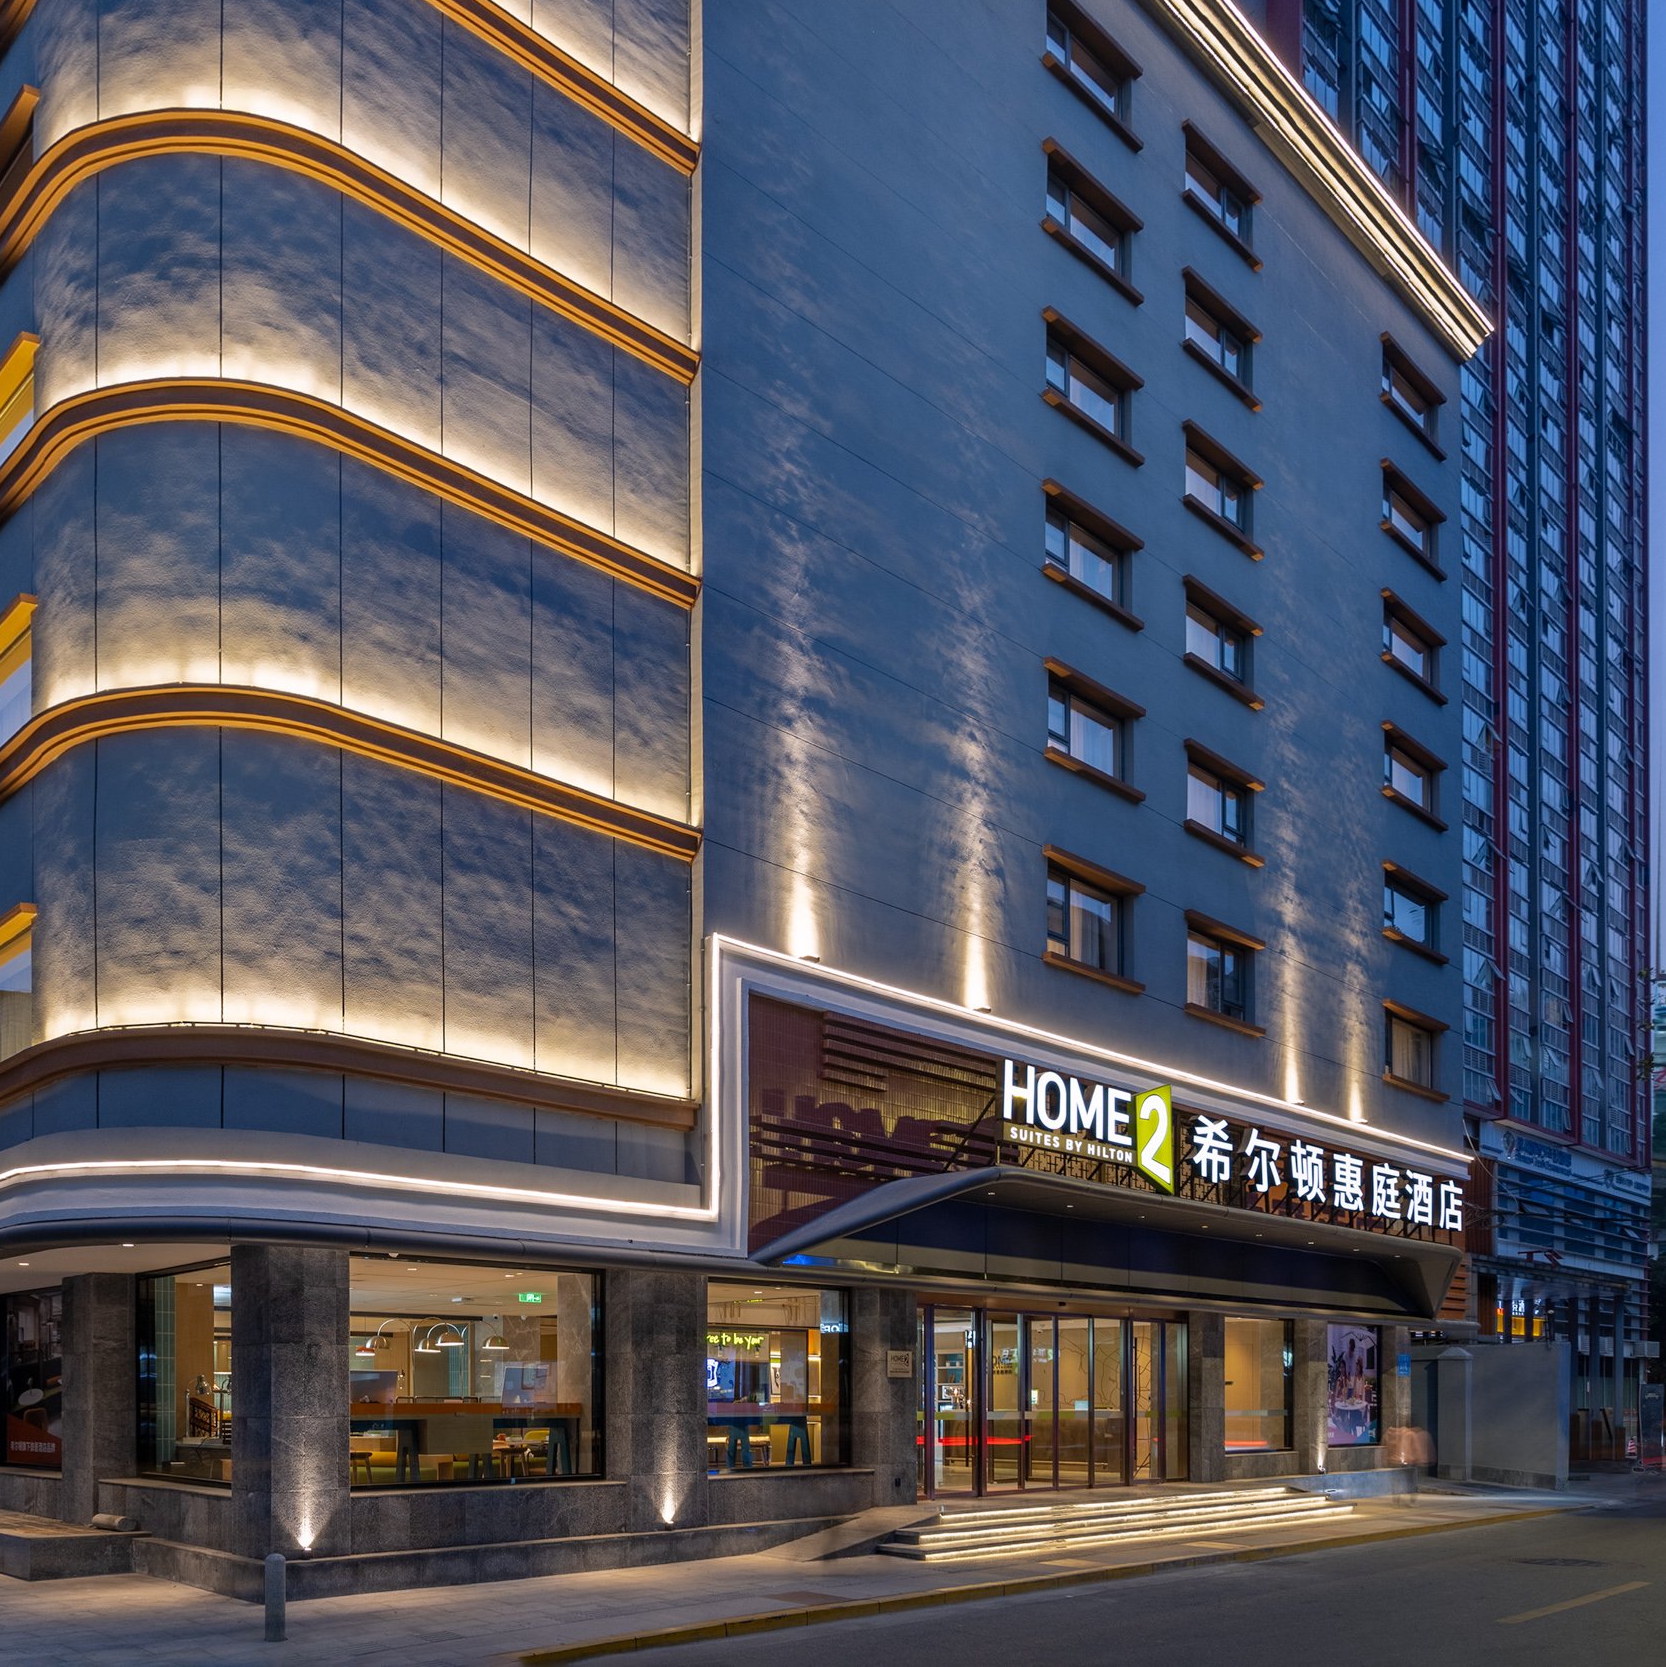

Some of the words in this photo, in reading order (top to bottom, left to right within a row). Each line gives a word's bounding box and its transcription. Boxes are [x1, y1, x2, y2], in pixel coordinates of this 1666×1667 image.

[1010, 1126, 1060, 1149] SUITES
[1065, 1138, 1083, 1153] BY
[1087, 1143, 1133, 1164] HILTON
[1192, 1114, 1464, 1232] 希尔顿惠庭酒店
[721, 1332, 732, 1346] to
